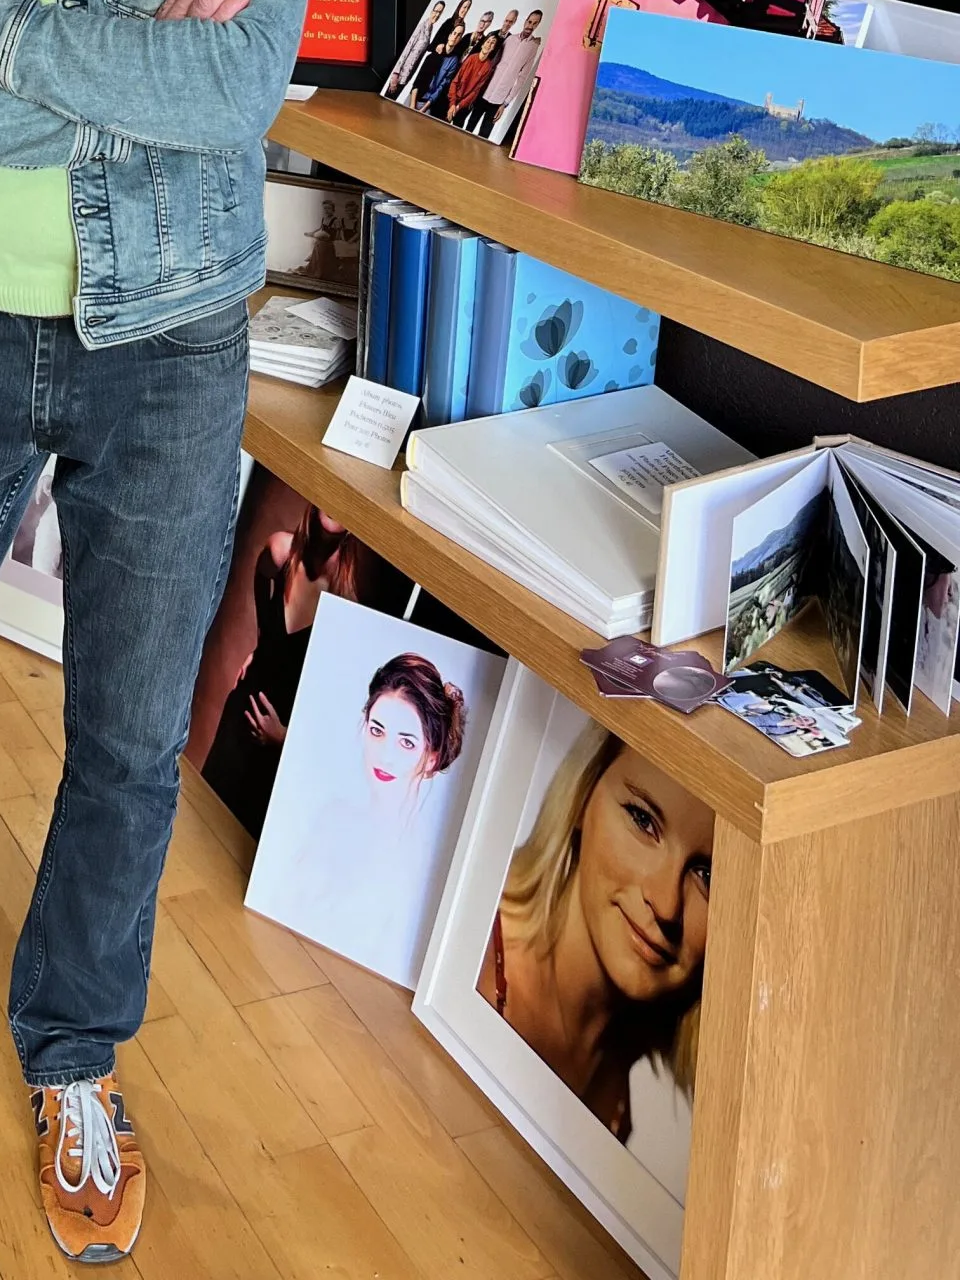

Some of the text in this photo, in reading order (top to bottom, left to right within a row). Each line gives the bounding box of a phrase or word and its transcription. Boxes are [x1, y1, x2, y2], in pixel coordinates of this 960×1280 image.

[311, 12, 363, 23] du Vignoble
[303, 30, 315, 38] du
[317, 31, 337, 41] Pays
[338, 33, 349, 41] de
